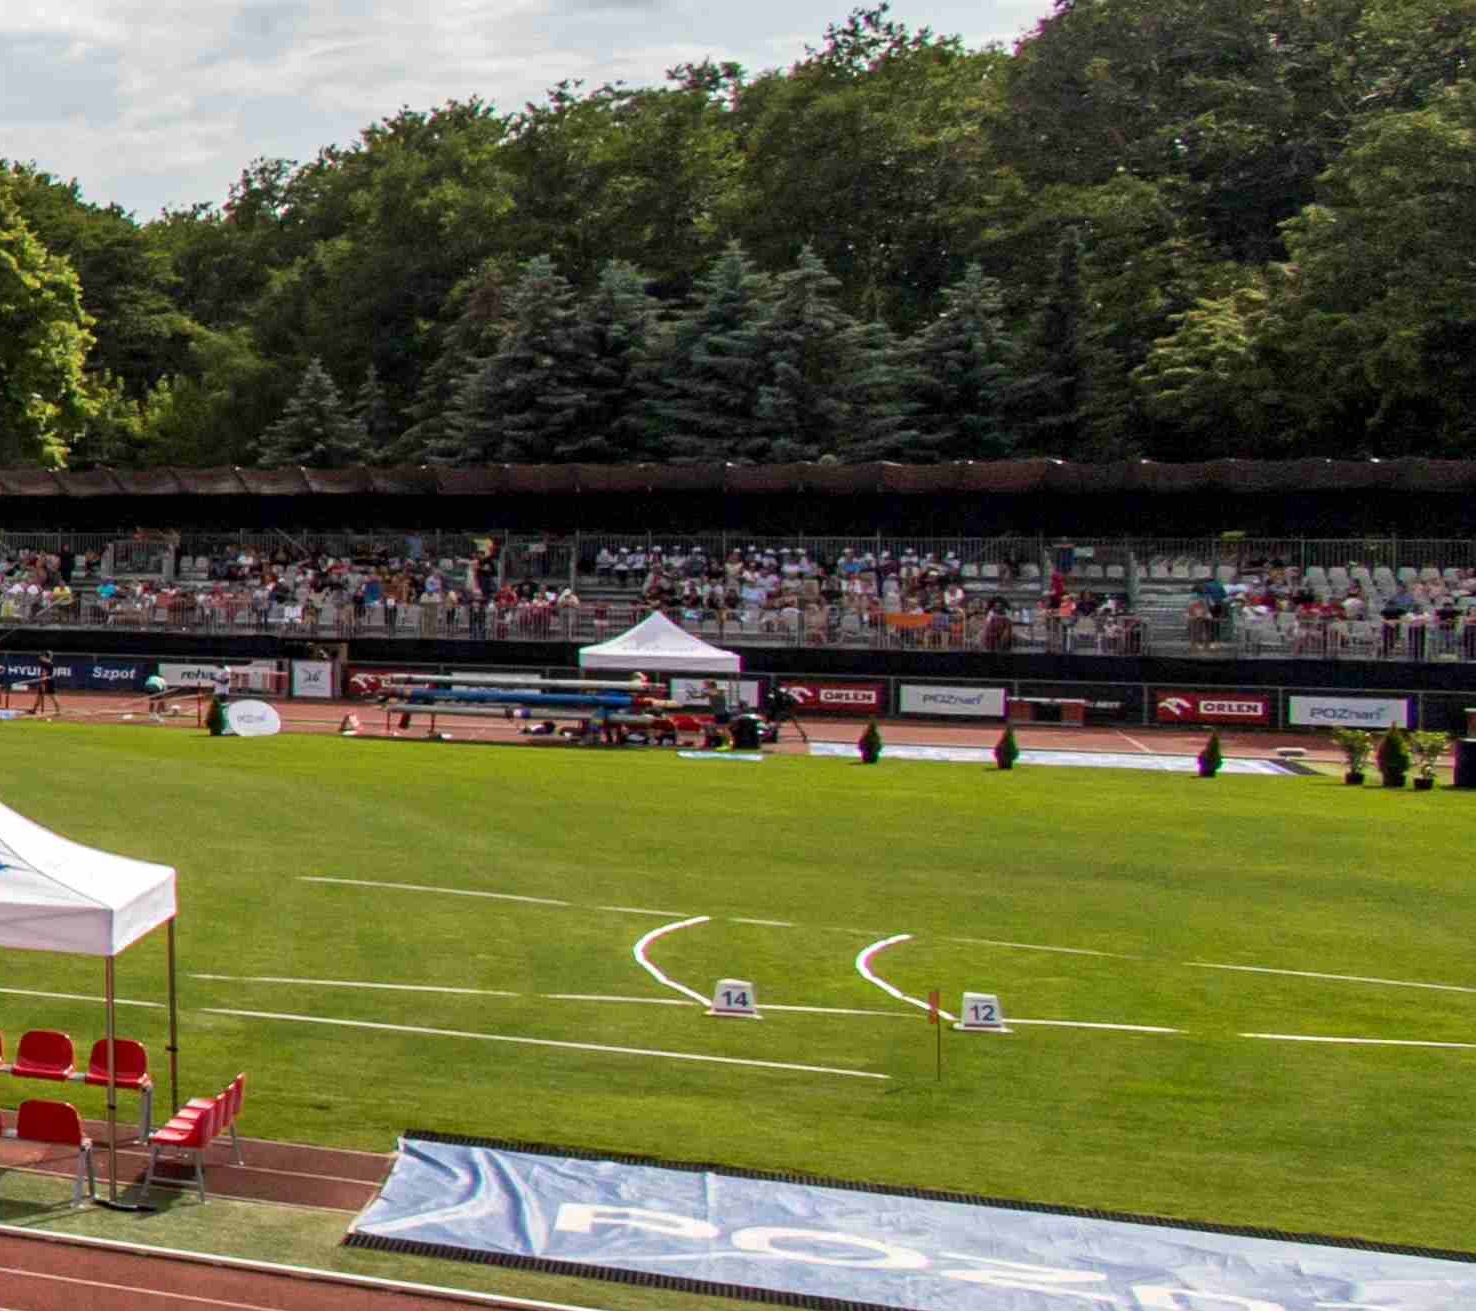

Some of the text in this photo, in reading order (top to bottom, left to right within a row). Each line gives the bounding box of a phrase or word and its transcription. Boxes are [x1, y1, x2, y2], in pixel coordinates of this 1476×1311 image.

[824, 690, 873, 702] ORLEN
[1202, 702, 1259, 714] ORLEN
[1309, 706, 1381, 720] POZnan
[722, 990, 749, 1007] 14
[970, 1004, 995, 1022] 12
